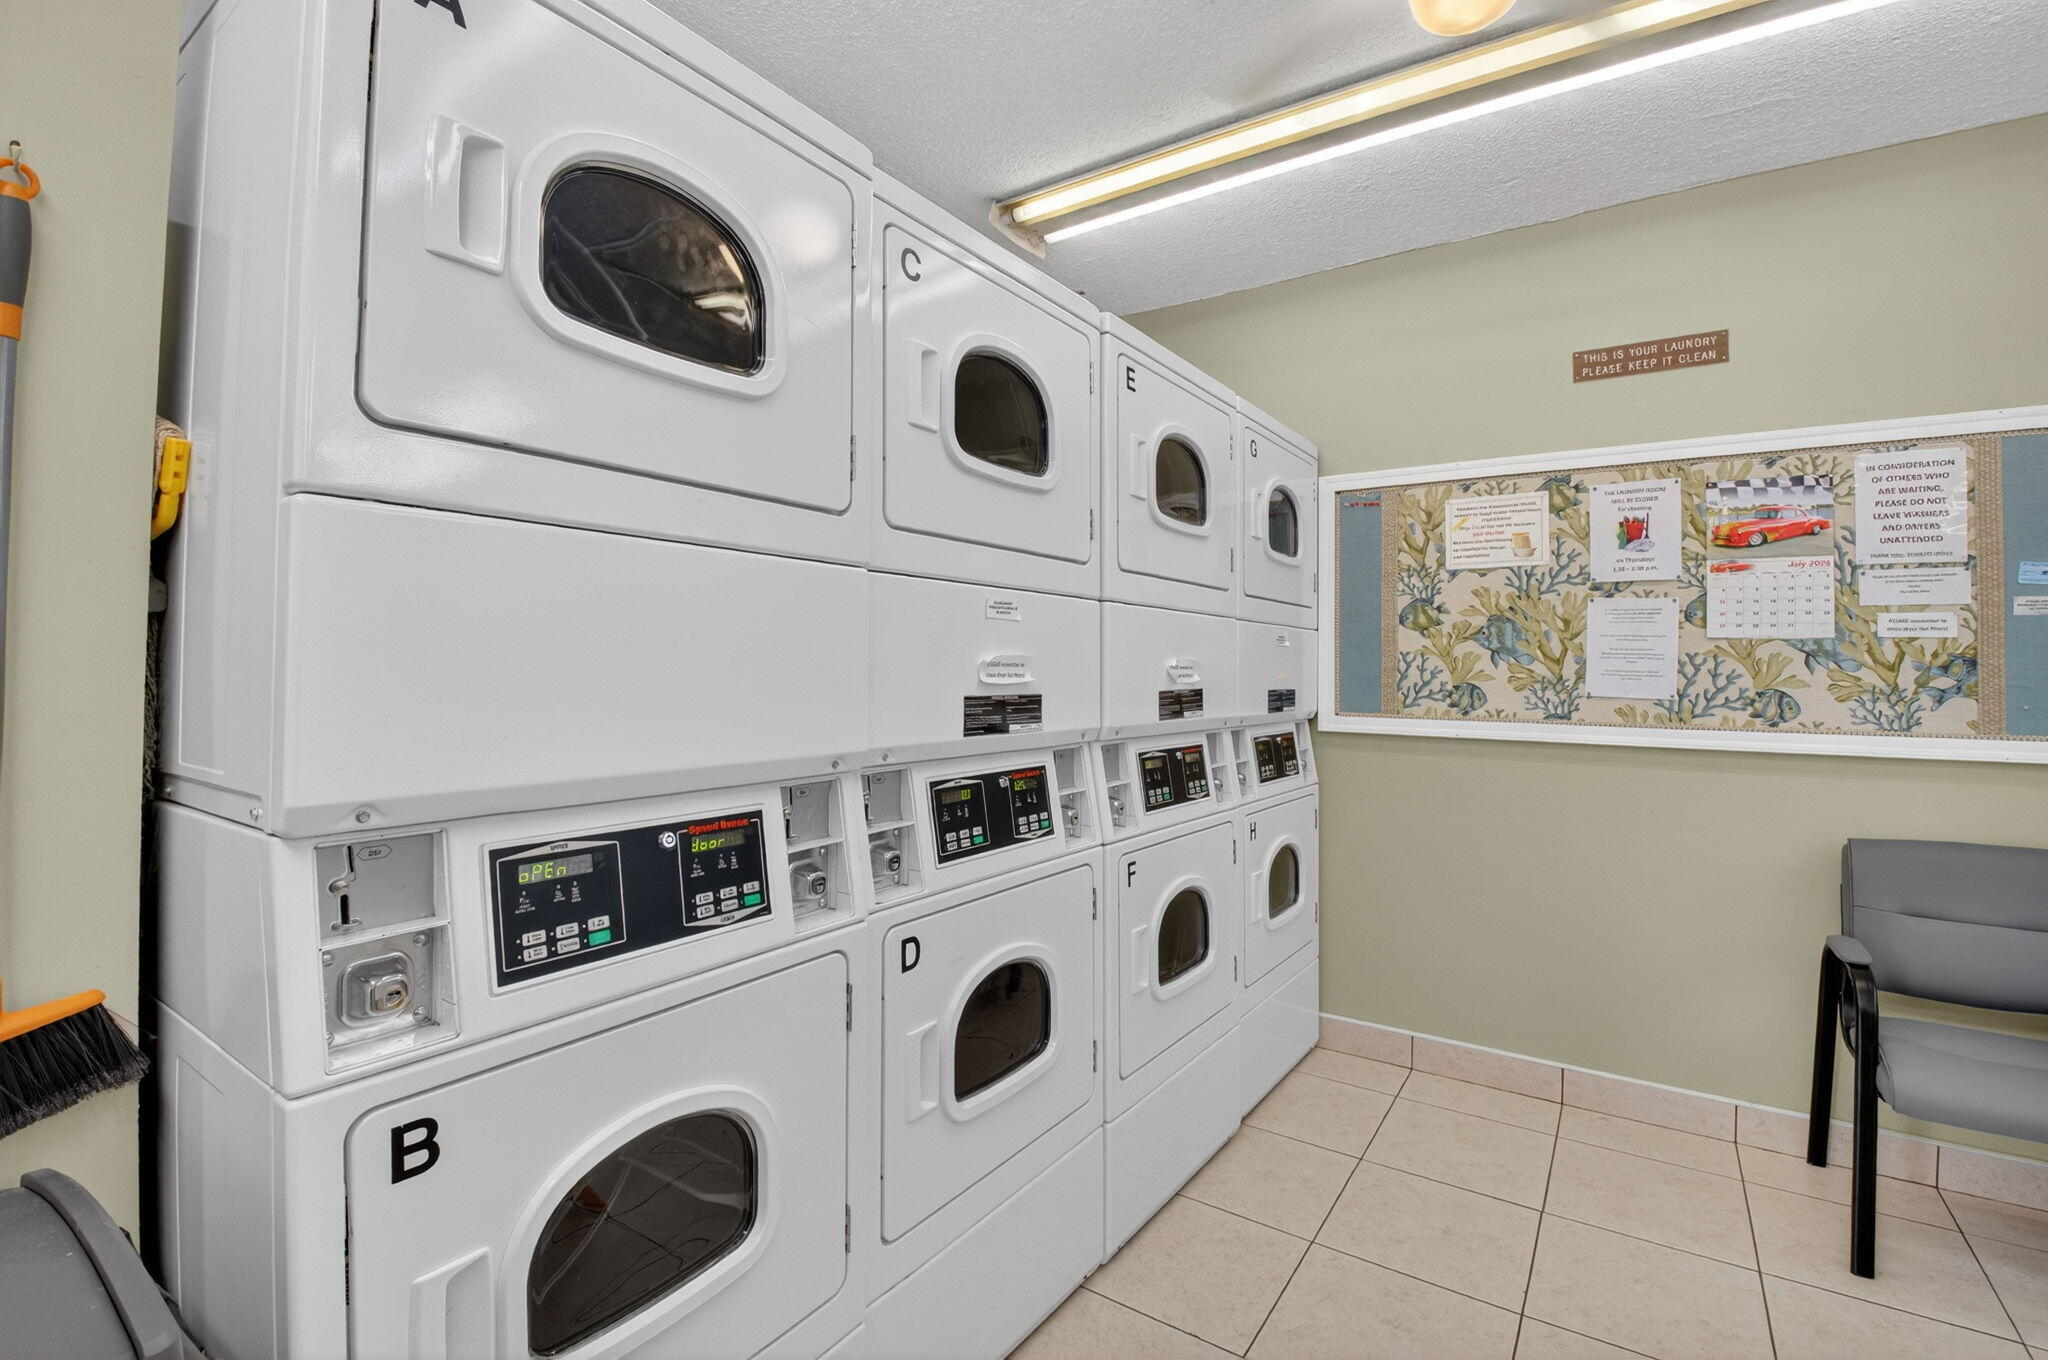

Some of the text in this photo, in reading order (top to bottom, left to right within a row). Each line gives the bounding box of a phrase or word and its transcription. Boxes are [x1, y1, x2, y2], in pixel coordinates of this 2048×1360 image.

[901, 248, 922, 282] C
[1582, 350, 1716, 377] PLEASE KEEP IT CLEAN
[1583, 352, 1607, 363] THIS
[1613, 351, 1624, 360] IS
[1629, 345, 1658, 357] YOUR
[1126, 365, 1136, 393] E
[1250, 439, 1259, 458] G
[1924, 472, 1950, 480] WHO
[1927, 497, 1947, 505] NOT
[1250, 822, 1257, 841] H
[1127, 860, 1137, 888] F
[902, 937, 921, 974] D
[391, 1117, 441, 1184] B
